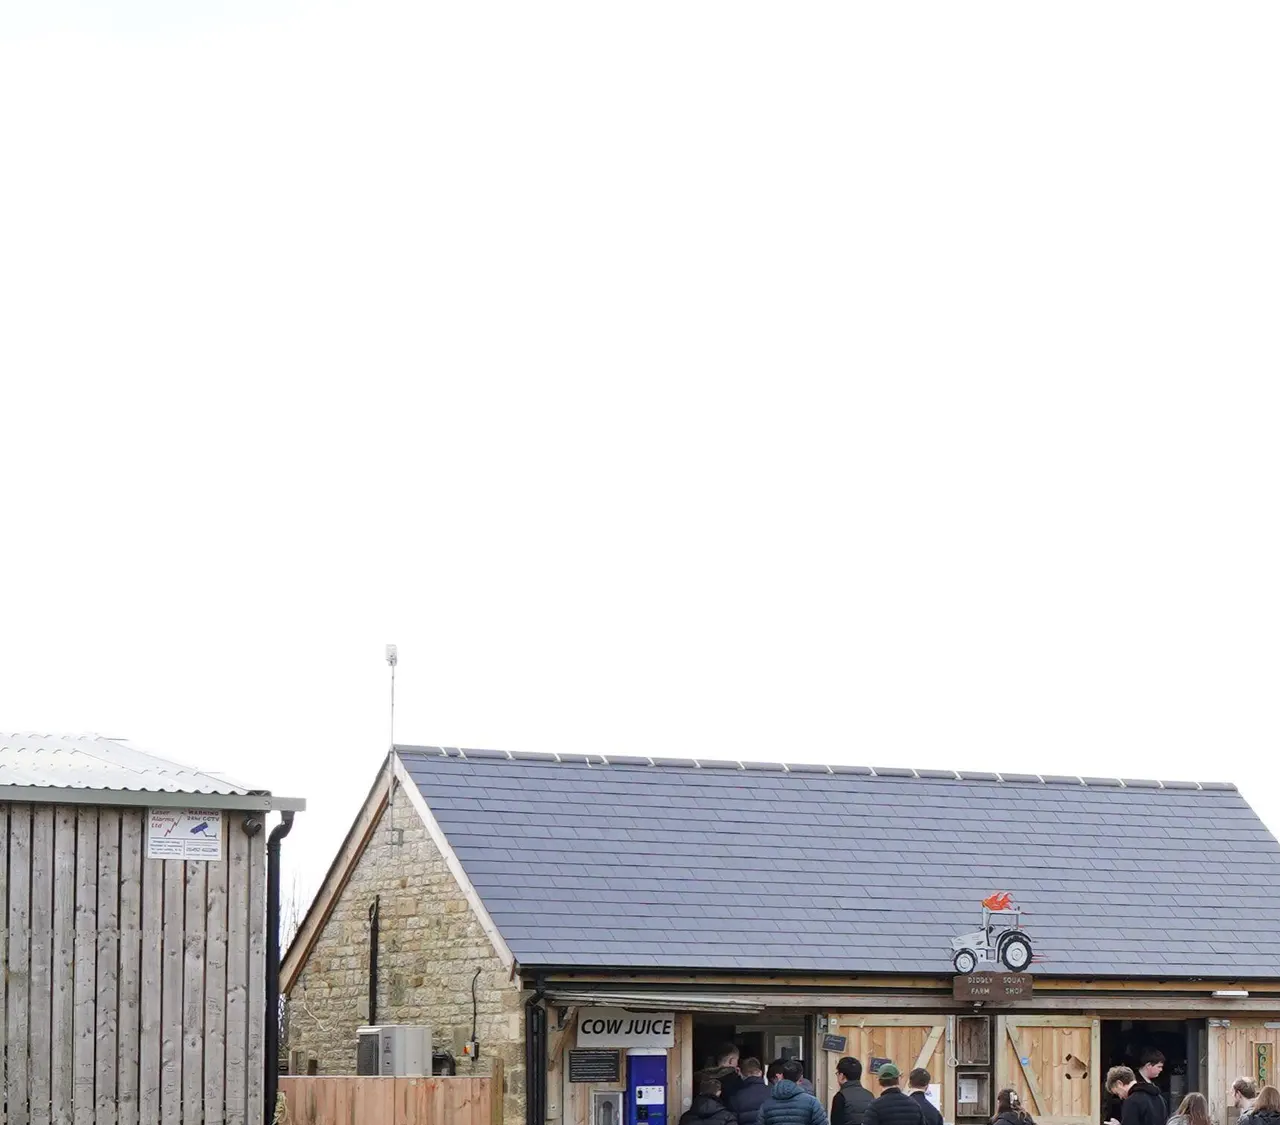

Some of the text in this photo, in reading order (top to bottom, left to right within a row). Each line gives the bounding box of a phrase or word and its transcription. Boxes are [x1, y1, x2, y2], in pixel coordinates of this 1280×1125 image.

[967, 976, 1026, 984] DIDDLY SQUAT
[971, 987, 1023, 995] FARM SHOP
[581, 1019, 673, 1035] COW JUICE
